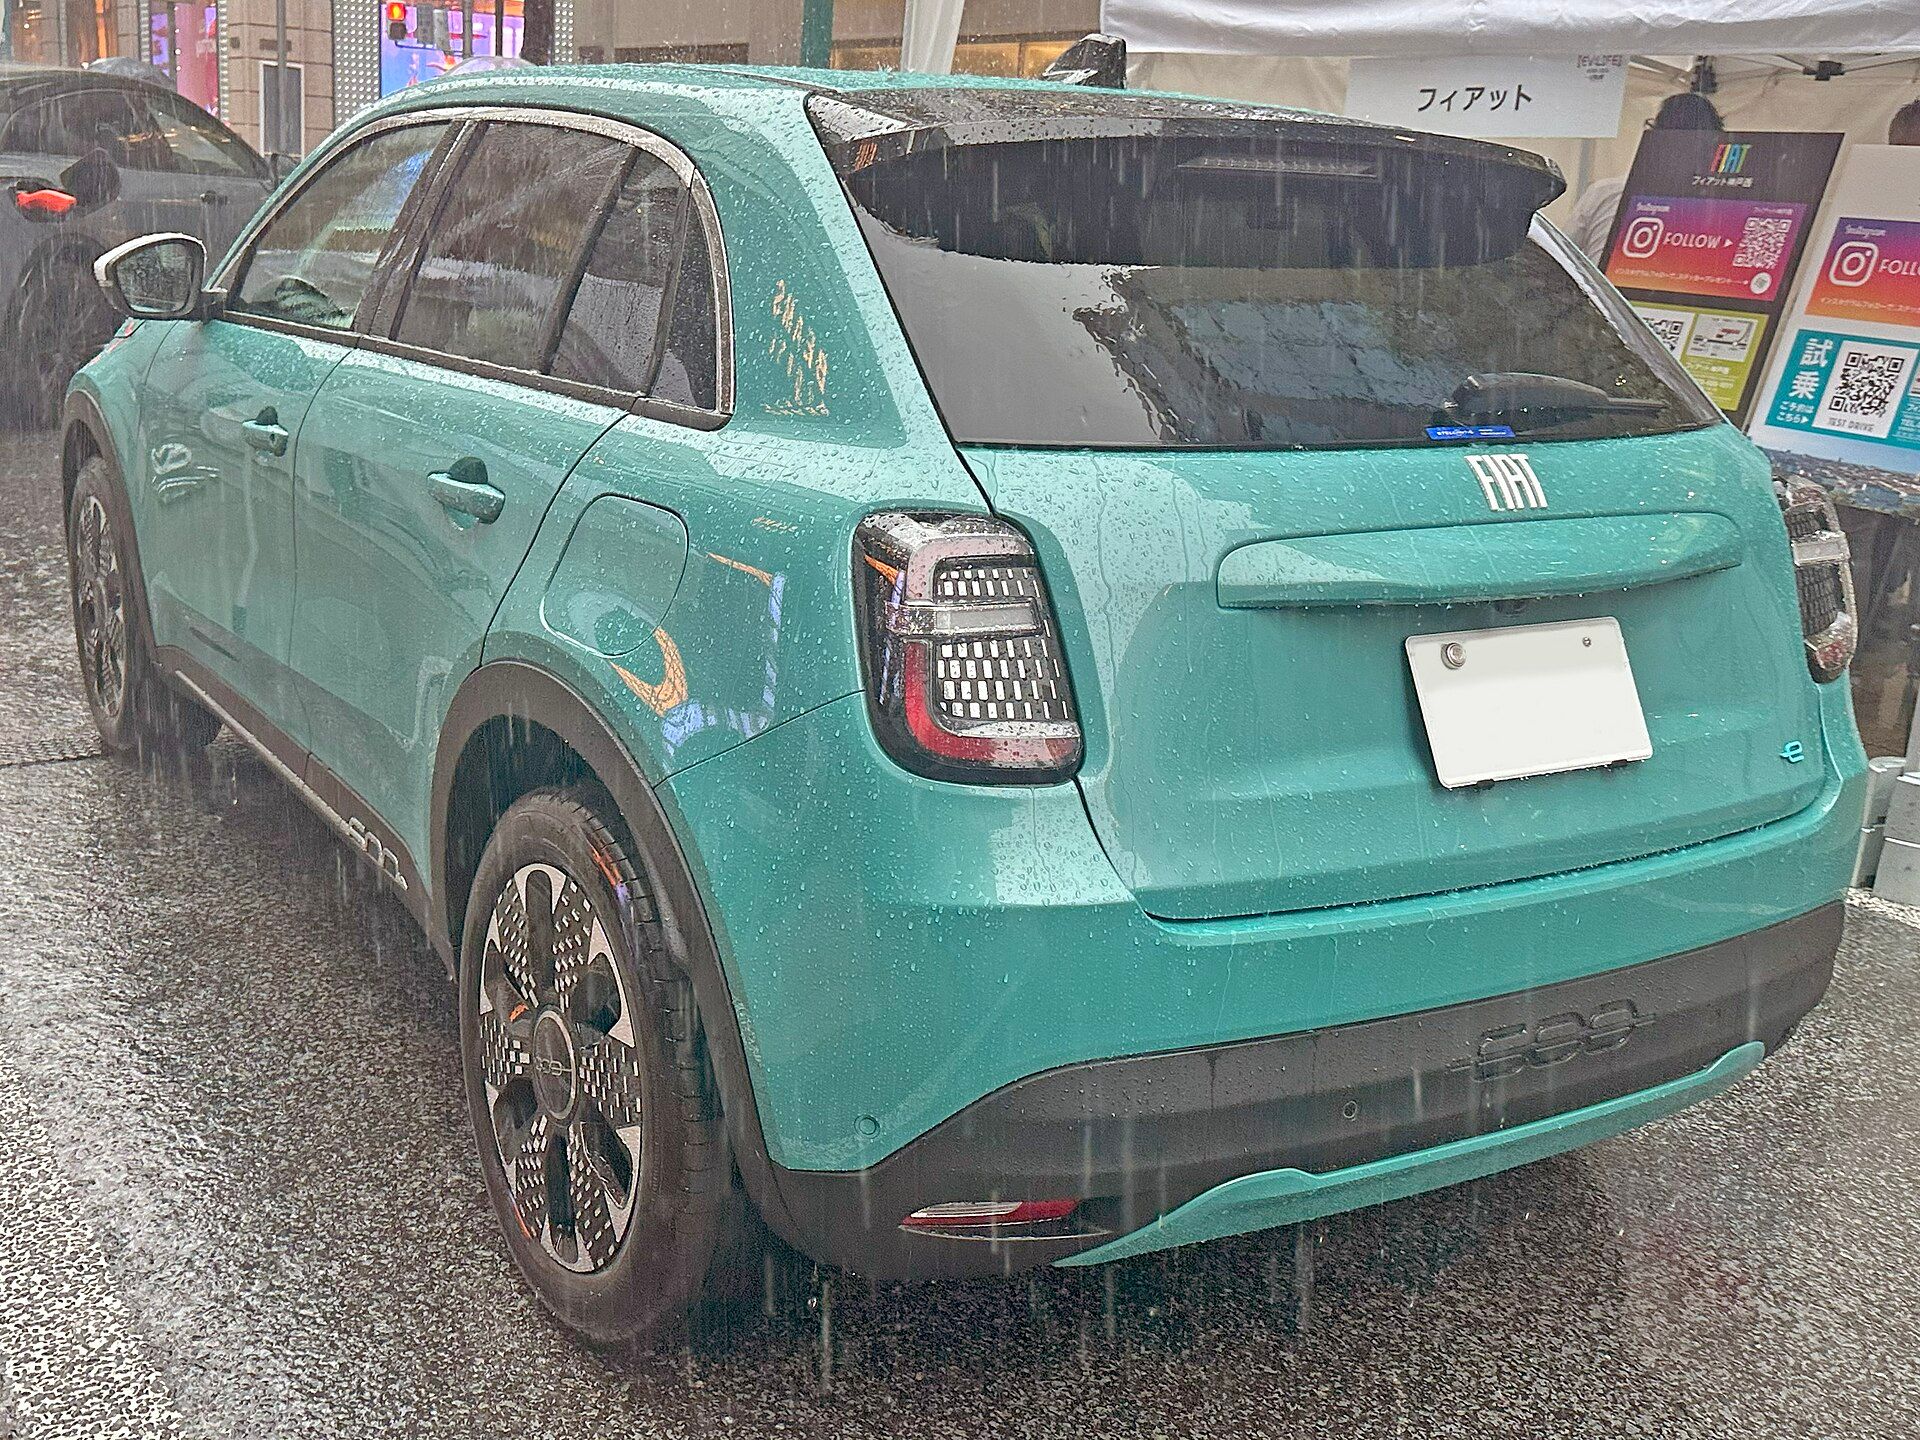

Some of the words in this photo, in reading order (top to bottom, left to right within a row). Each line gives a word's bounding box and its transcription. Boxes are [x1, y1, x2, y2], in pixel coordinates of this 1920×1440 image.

[1418, 84, 1532, 112] フィアット
[1710, 143, 1753, 174] FIAT
[1662, 231, 1722, 249] FOLLOW
[1878, 258, 1920, 276] FOLL
[1788, 337, 1834, 399] 試乗
[1464, 453, 1549, 511] FIAT
[1472, 999, 1638, 1083] 500
